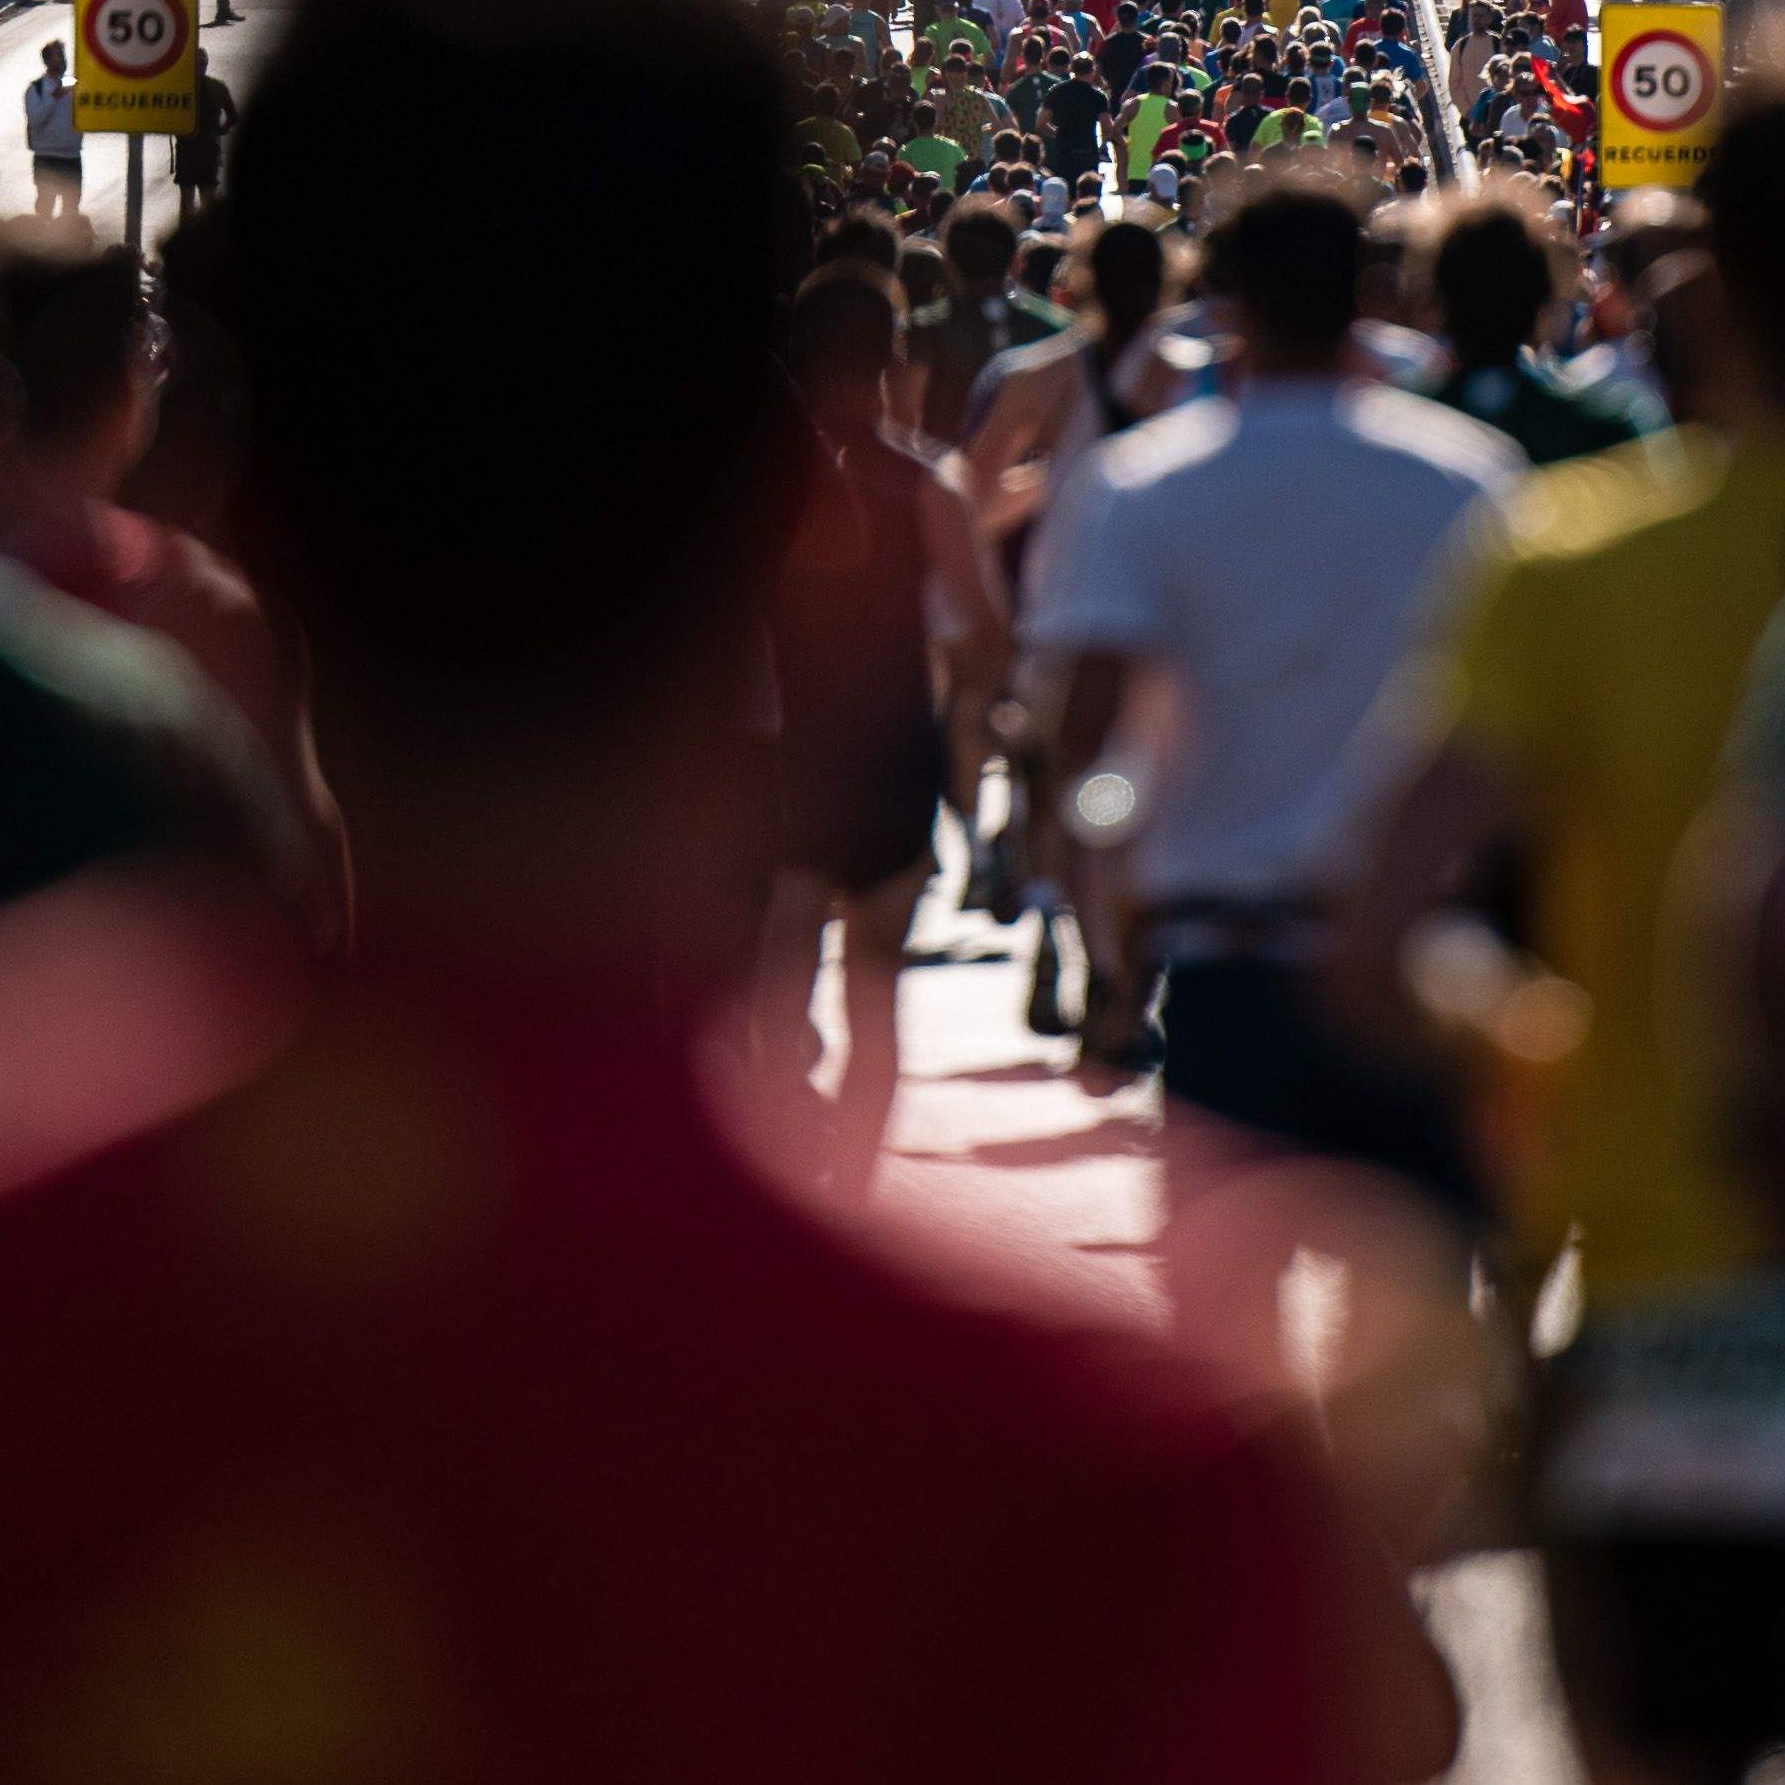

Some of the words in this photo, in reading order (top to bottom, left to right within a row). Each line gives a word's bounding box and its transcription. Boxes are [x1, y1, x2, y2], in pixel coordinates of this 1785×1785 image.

[107, 10, 165, 45] 50
[1633, 64, 1690, 99] 50
[77, 91, 193, 109] RECUERDE
